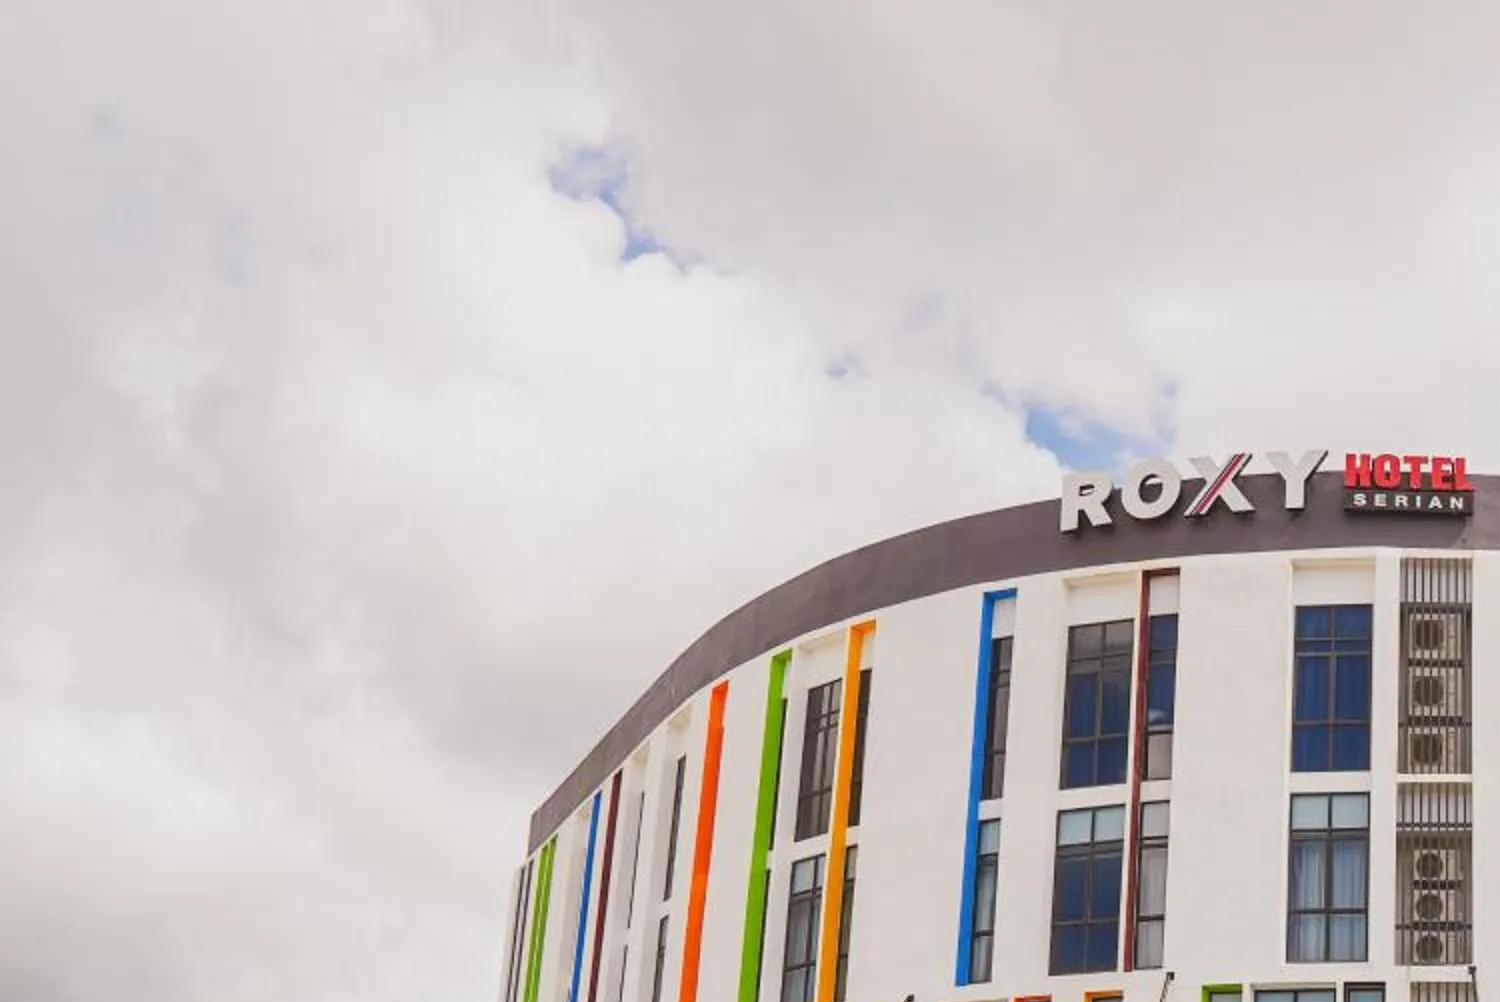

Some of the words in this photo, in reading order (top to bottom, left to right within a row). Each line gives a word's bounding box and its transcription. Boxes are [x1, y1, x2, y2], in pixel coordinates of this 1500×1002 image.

[1060, 449, 1329, 533] ROXY
[1343, 453, 1474, 491] HOTEL
[1352, 492, 1467, 510] SERIAN
